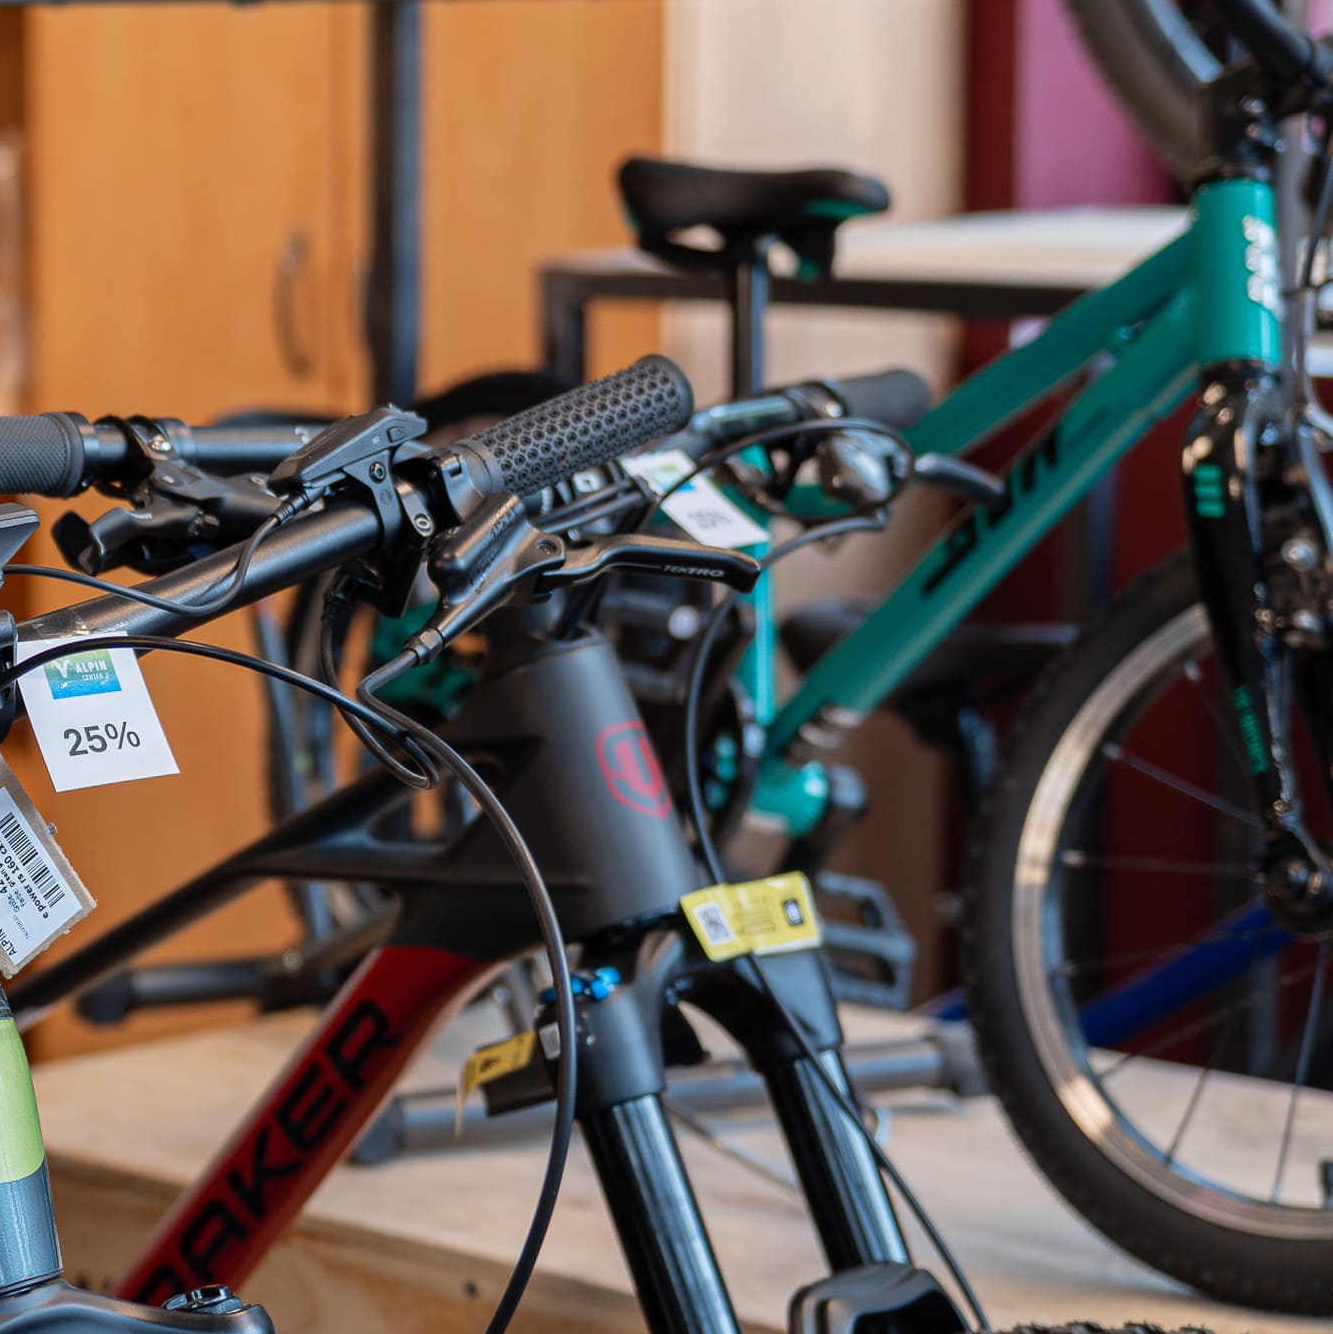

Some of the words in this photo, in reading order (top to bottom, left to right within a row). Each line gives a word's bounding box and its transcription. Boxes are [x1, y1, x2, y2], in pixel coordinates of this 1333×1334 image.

[75, 659, 108, 675] ALPIN
[63, 720, 141, 757] 25%
[4, 855, 20, 875] 160
[22, 881, 45, 912] power
